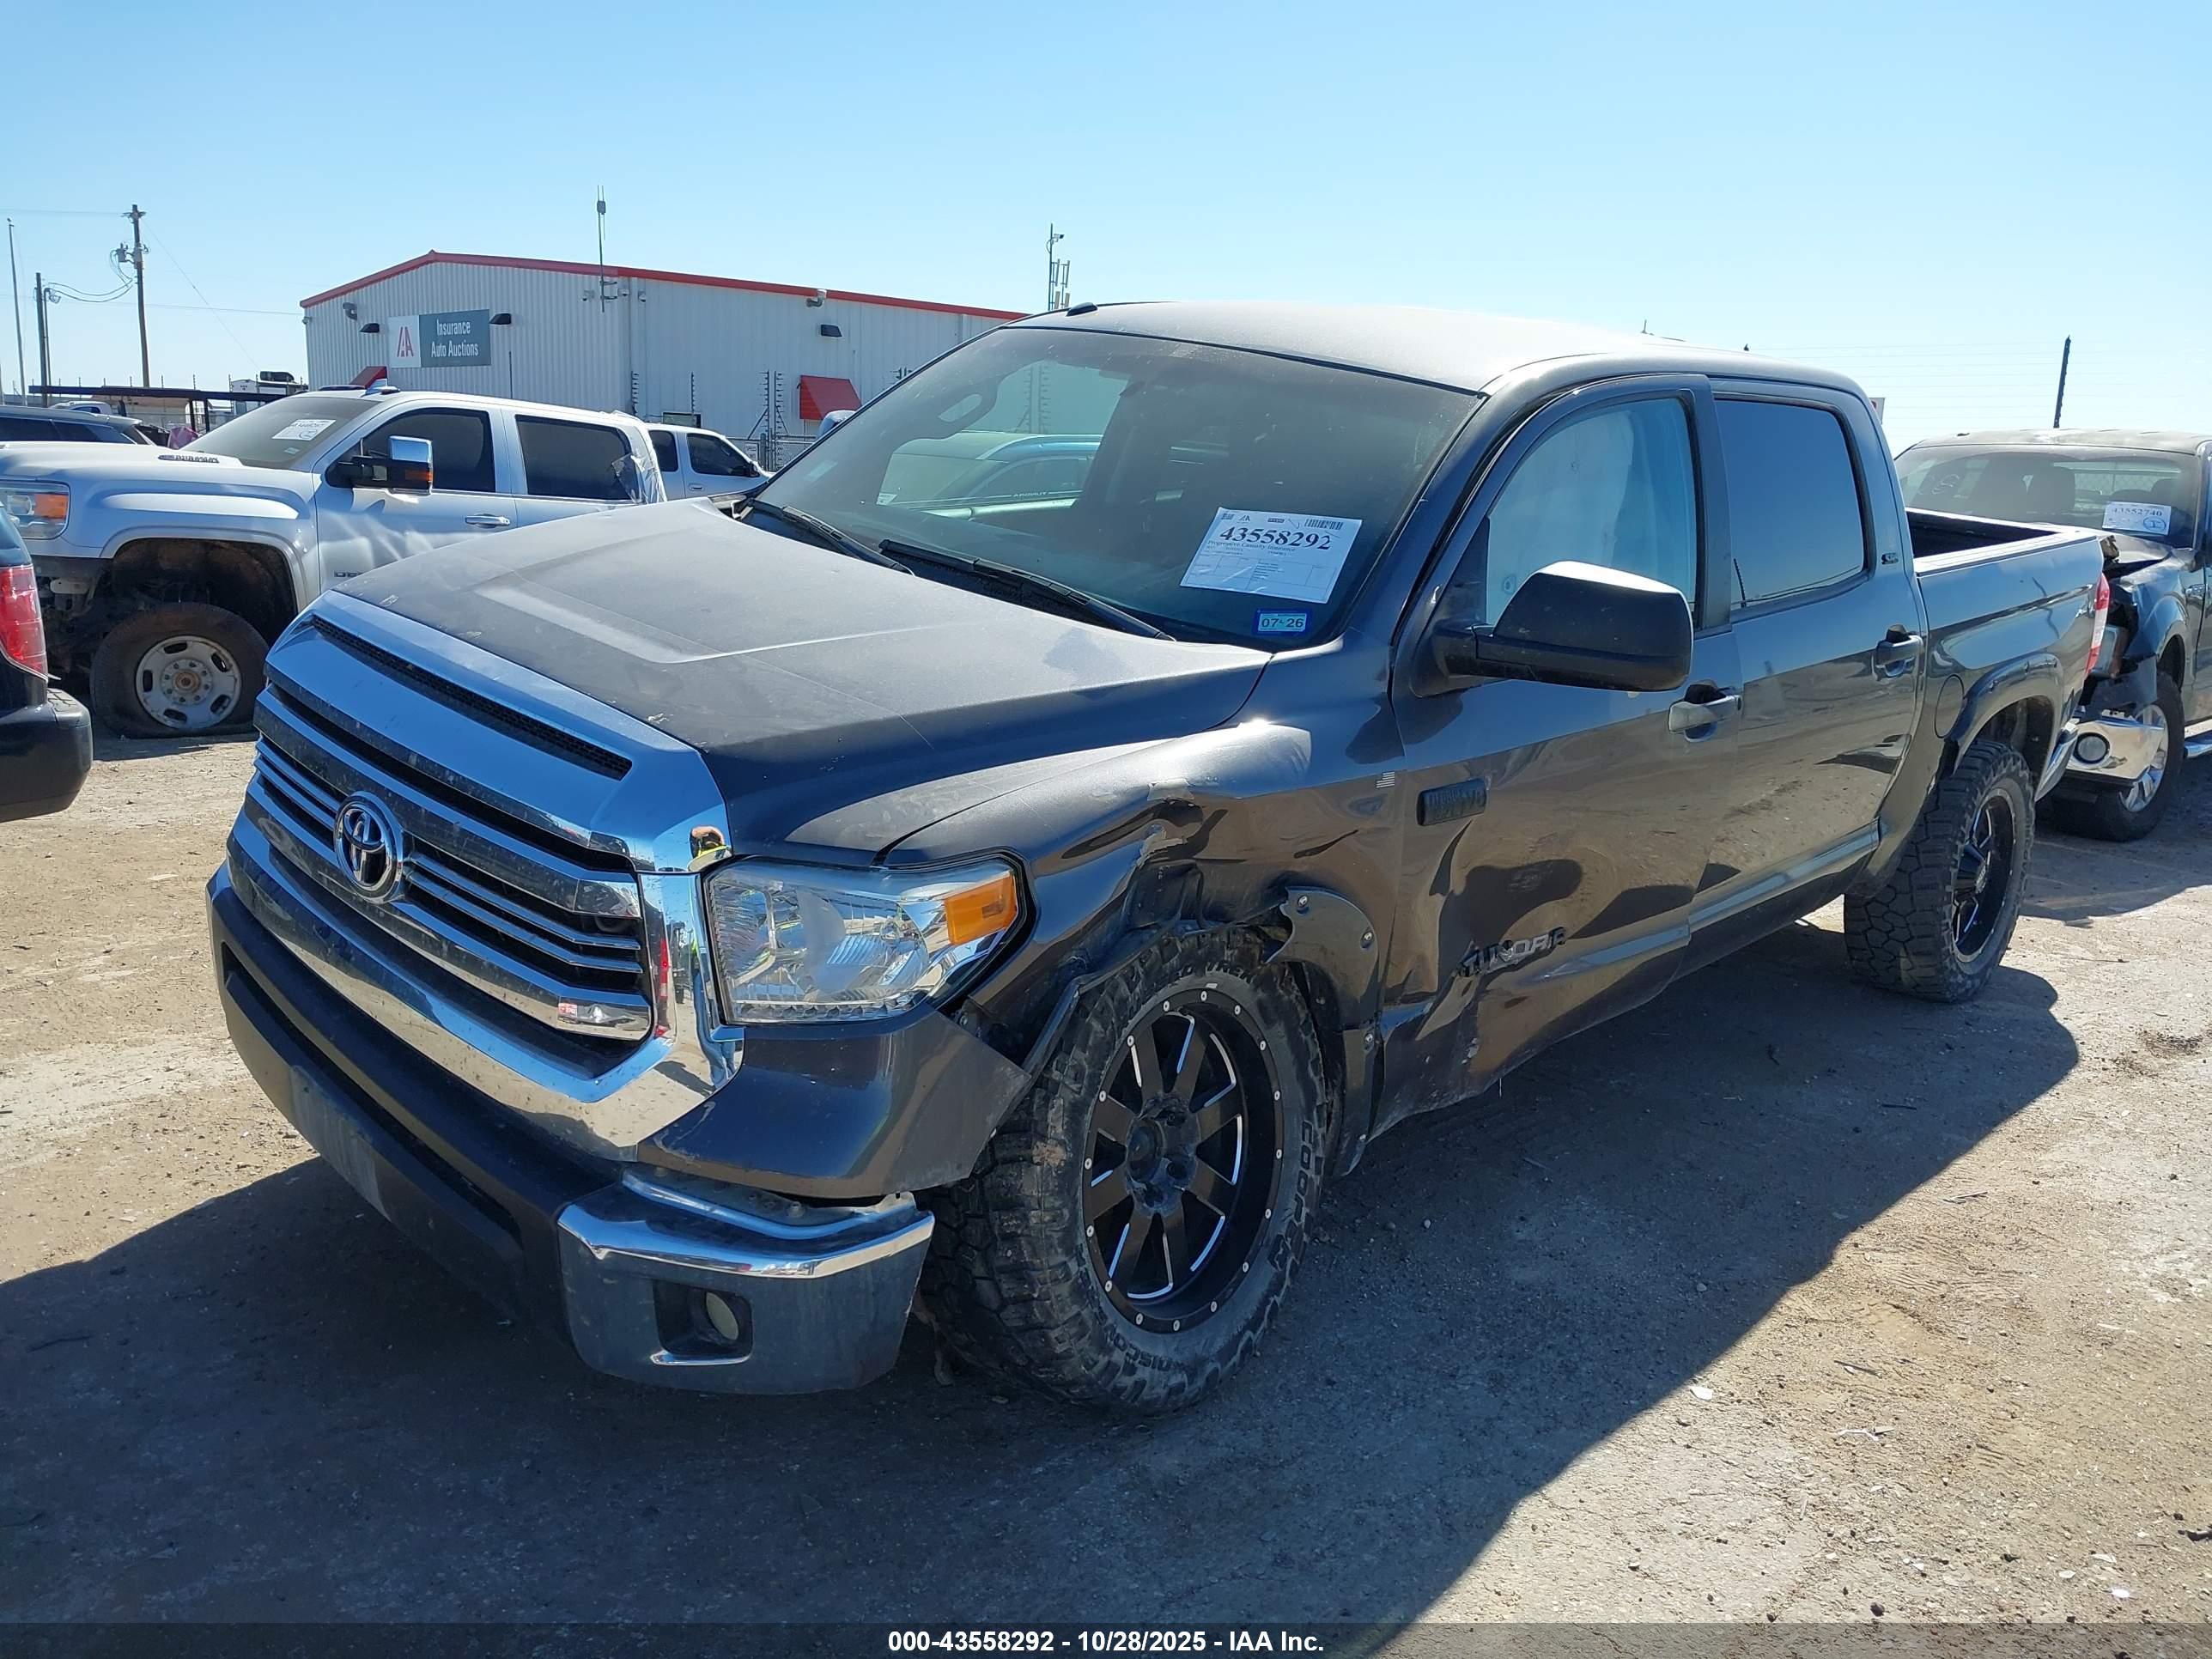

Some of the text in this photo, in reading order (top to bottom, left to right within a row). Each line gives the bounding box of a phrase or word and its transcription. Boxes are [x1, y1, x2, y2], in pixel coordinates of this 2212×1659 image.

[436, 319, 471, 336] Insurance
[431, 340, 479, 358] Auto Auctions
[1219, 526, 1332, 550] 43558292
